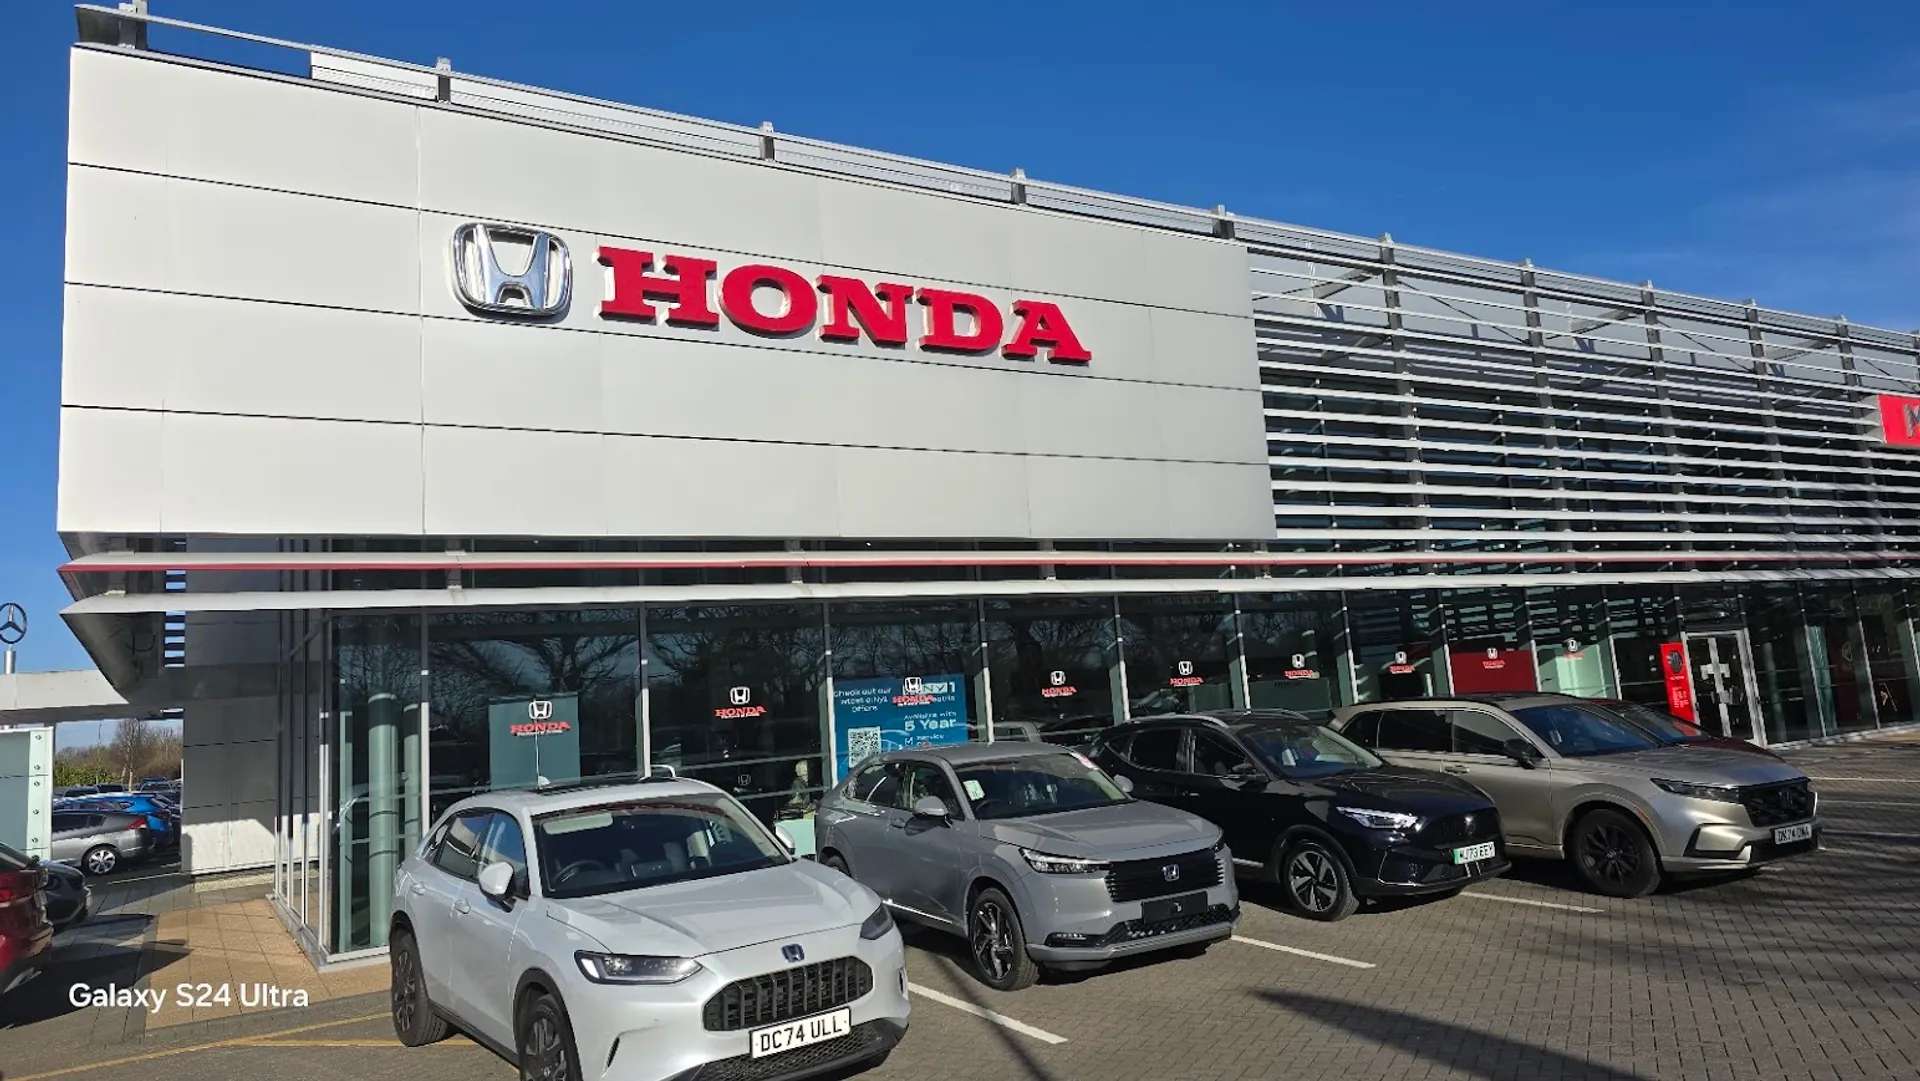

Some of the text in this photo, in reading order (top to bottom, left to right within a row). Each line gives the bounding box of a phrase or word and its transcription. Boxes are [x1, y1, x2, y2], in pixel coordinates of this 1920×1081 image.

[594, 246, 1092, 365] HONDA
[1041, 686, 1077, 695] HONDA
[892, 695, 934, 704] HONDA
[714, 705, 767, 717] HONDA
[511, 722, 571, 734] HONDA
[904, 718, 957, 732] 5 Year
[760, 1015, 842, 1052] DC74 ULL
